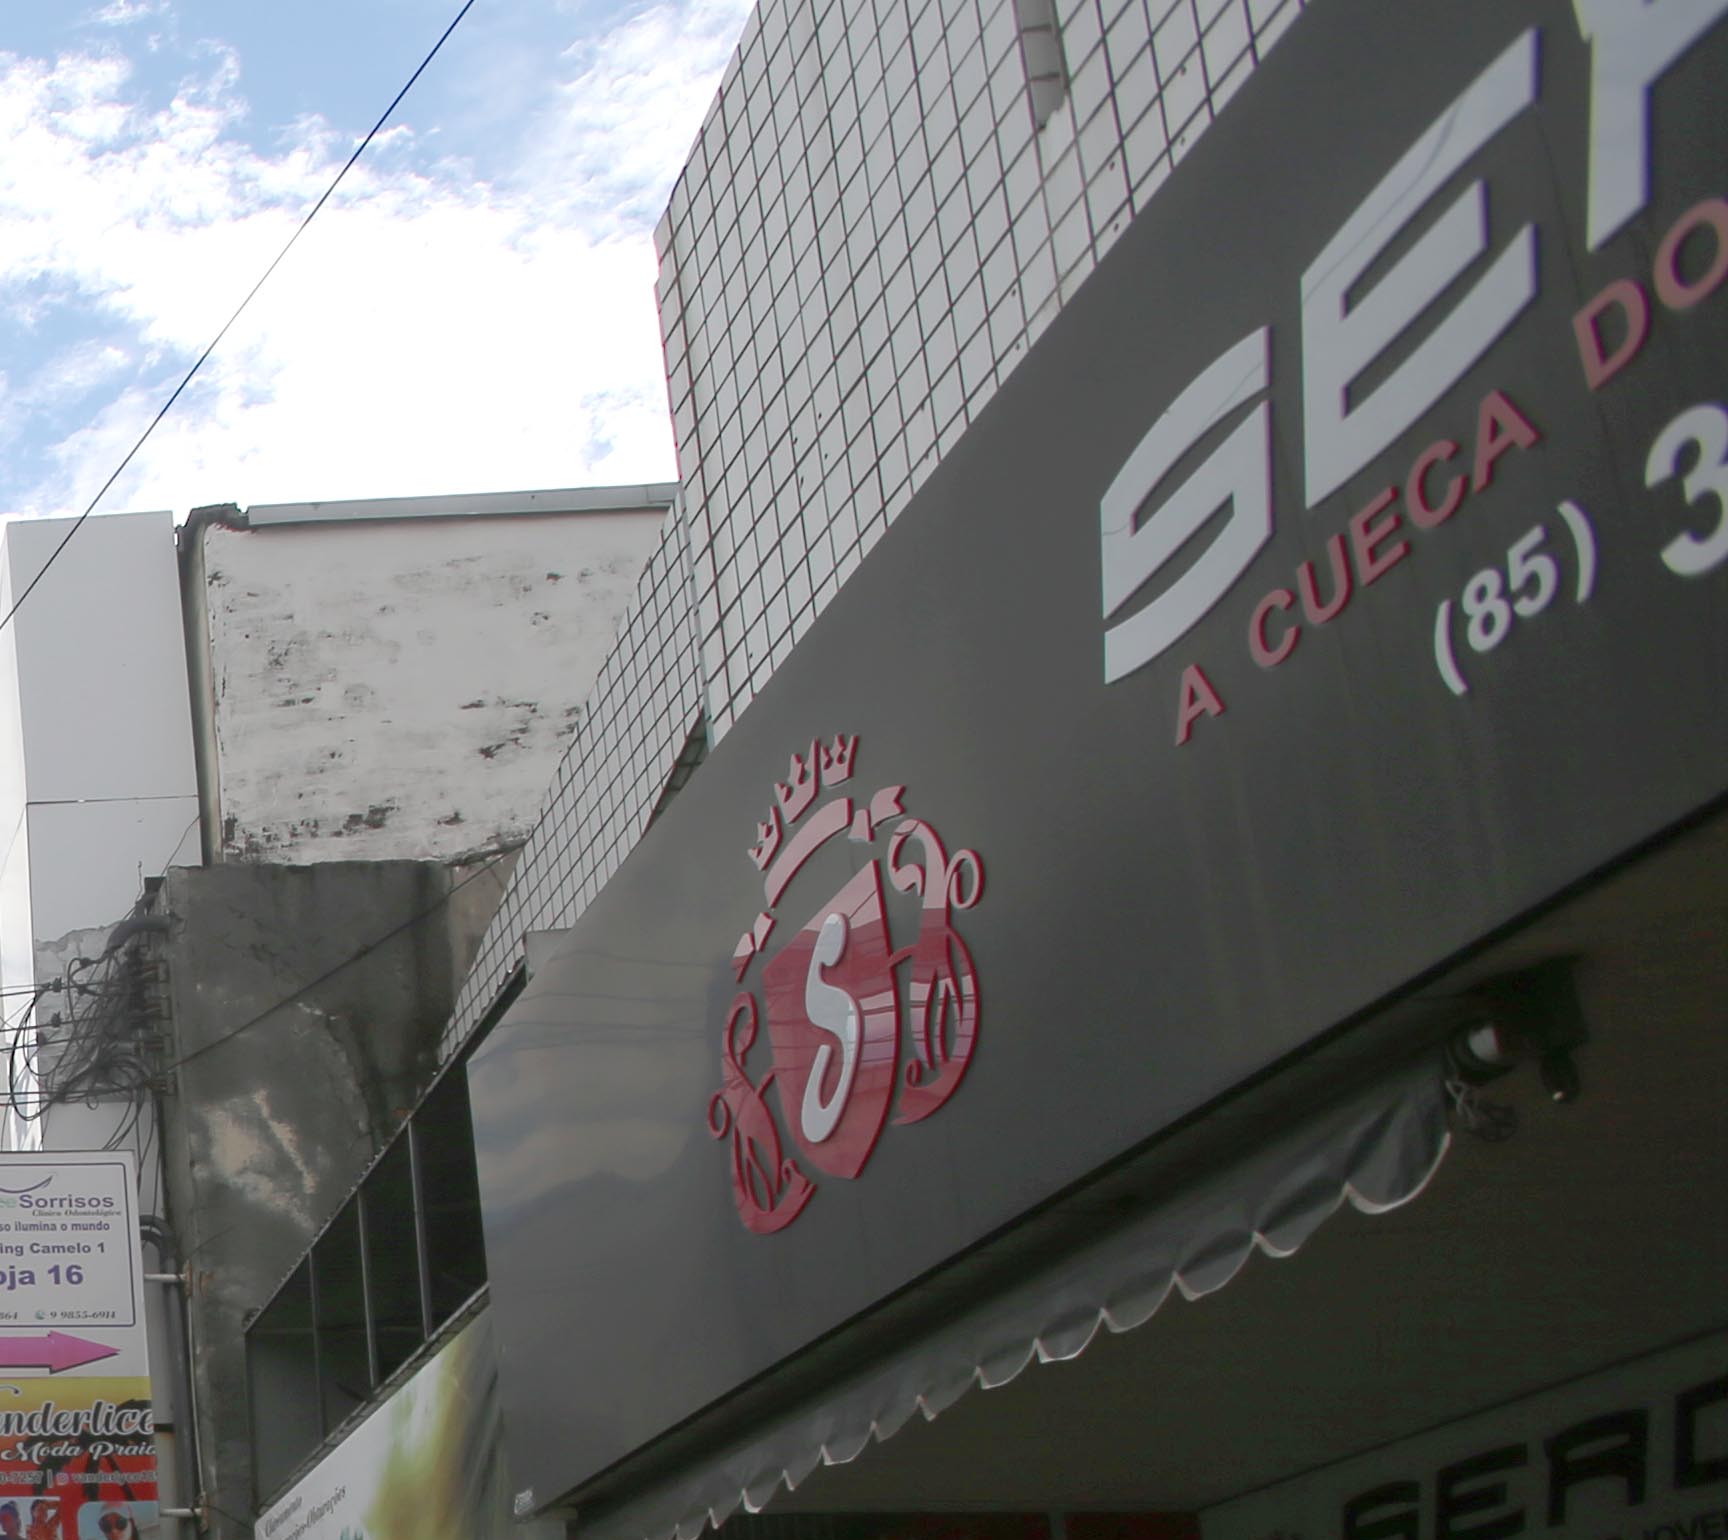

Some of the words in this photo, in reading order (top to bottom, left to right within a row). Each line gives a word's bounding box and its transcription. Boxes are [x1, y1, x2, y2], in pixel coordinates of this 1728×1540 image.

[1176, 662, 1226, 746] A
[1247, 388, 1541, 670] CUECA
[1433, 500, 1597, 695] (85)
[14, 1221, 57, 1232] ilumina
[60, 1223, 68, 1232] o
[71, 1220, 110, 1232] mundo
[29, 1242, 91, 1254] Camelo
[96, 1242, 106, 1253] 1
[47, 1264, 84, 1285] 16
[0, 1441, 82, 1464] Moda
